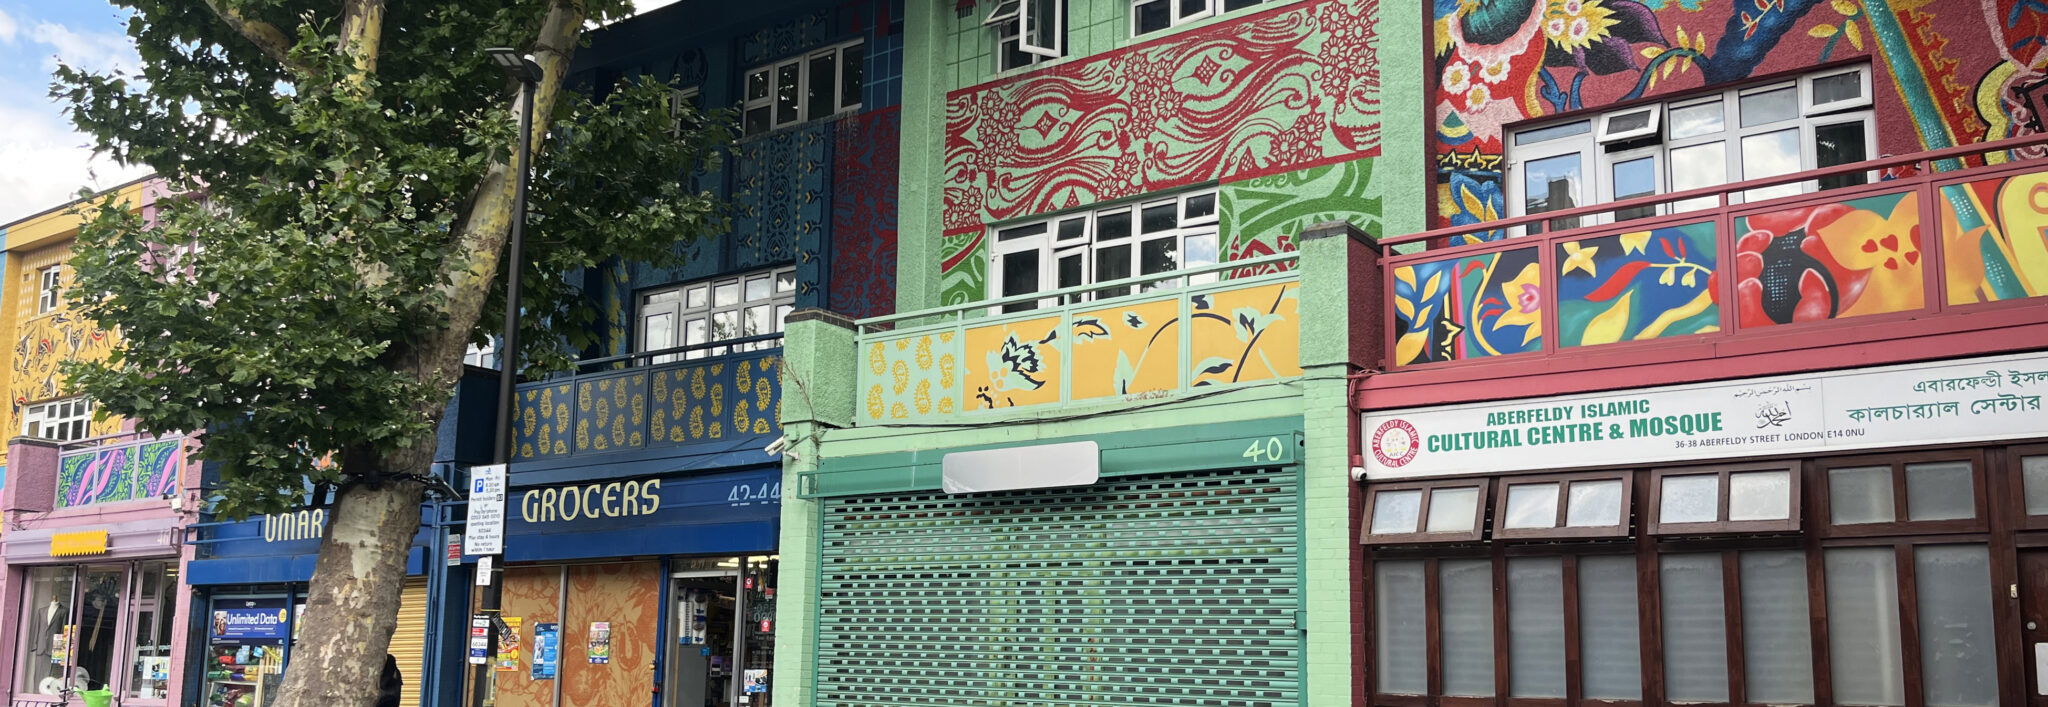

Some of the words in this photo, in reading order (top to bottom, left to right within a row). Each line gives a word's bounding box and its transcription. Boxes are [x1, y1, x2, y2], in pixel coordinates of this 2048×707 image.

[1487, 406, 1573, 426] ABERFELDY
[1581, 399, 1650, 419] ISLAMIC
[1373, 420, 1398, 448] ABERFELDY
[1399, 420, 1419, 444] ISLAMIC
[1427, 428, 1522, 453] CULTURAL
[1527, 422, 1603, 446] CENTRE
[1609, 423, 1624, 440] &
[1629, 412, 1722, 438] MOSQUE
[1675, 439, 1698, 449] 36-38
[1699, 436, 1746, 448] ABERFELDY
[1750, 434, 1780, 444] STREET
[1784, 431, 1824, 442] LONDON
[1827, 430, 1843, 439] E14
[1242, 436, 1283, 462] 40
[476, 479, 483, 492] P
[728, 482, 781, 505] 42-44
[522, 479, 661, 523] GROCERS
[265, 508, 324, 543] UMAR
[227, 613, 259, 625] Unlimited
[260, 612, 278, 625] Data
